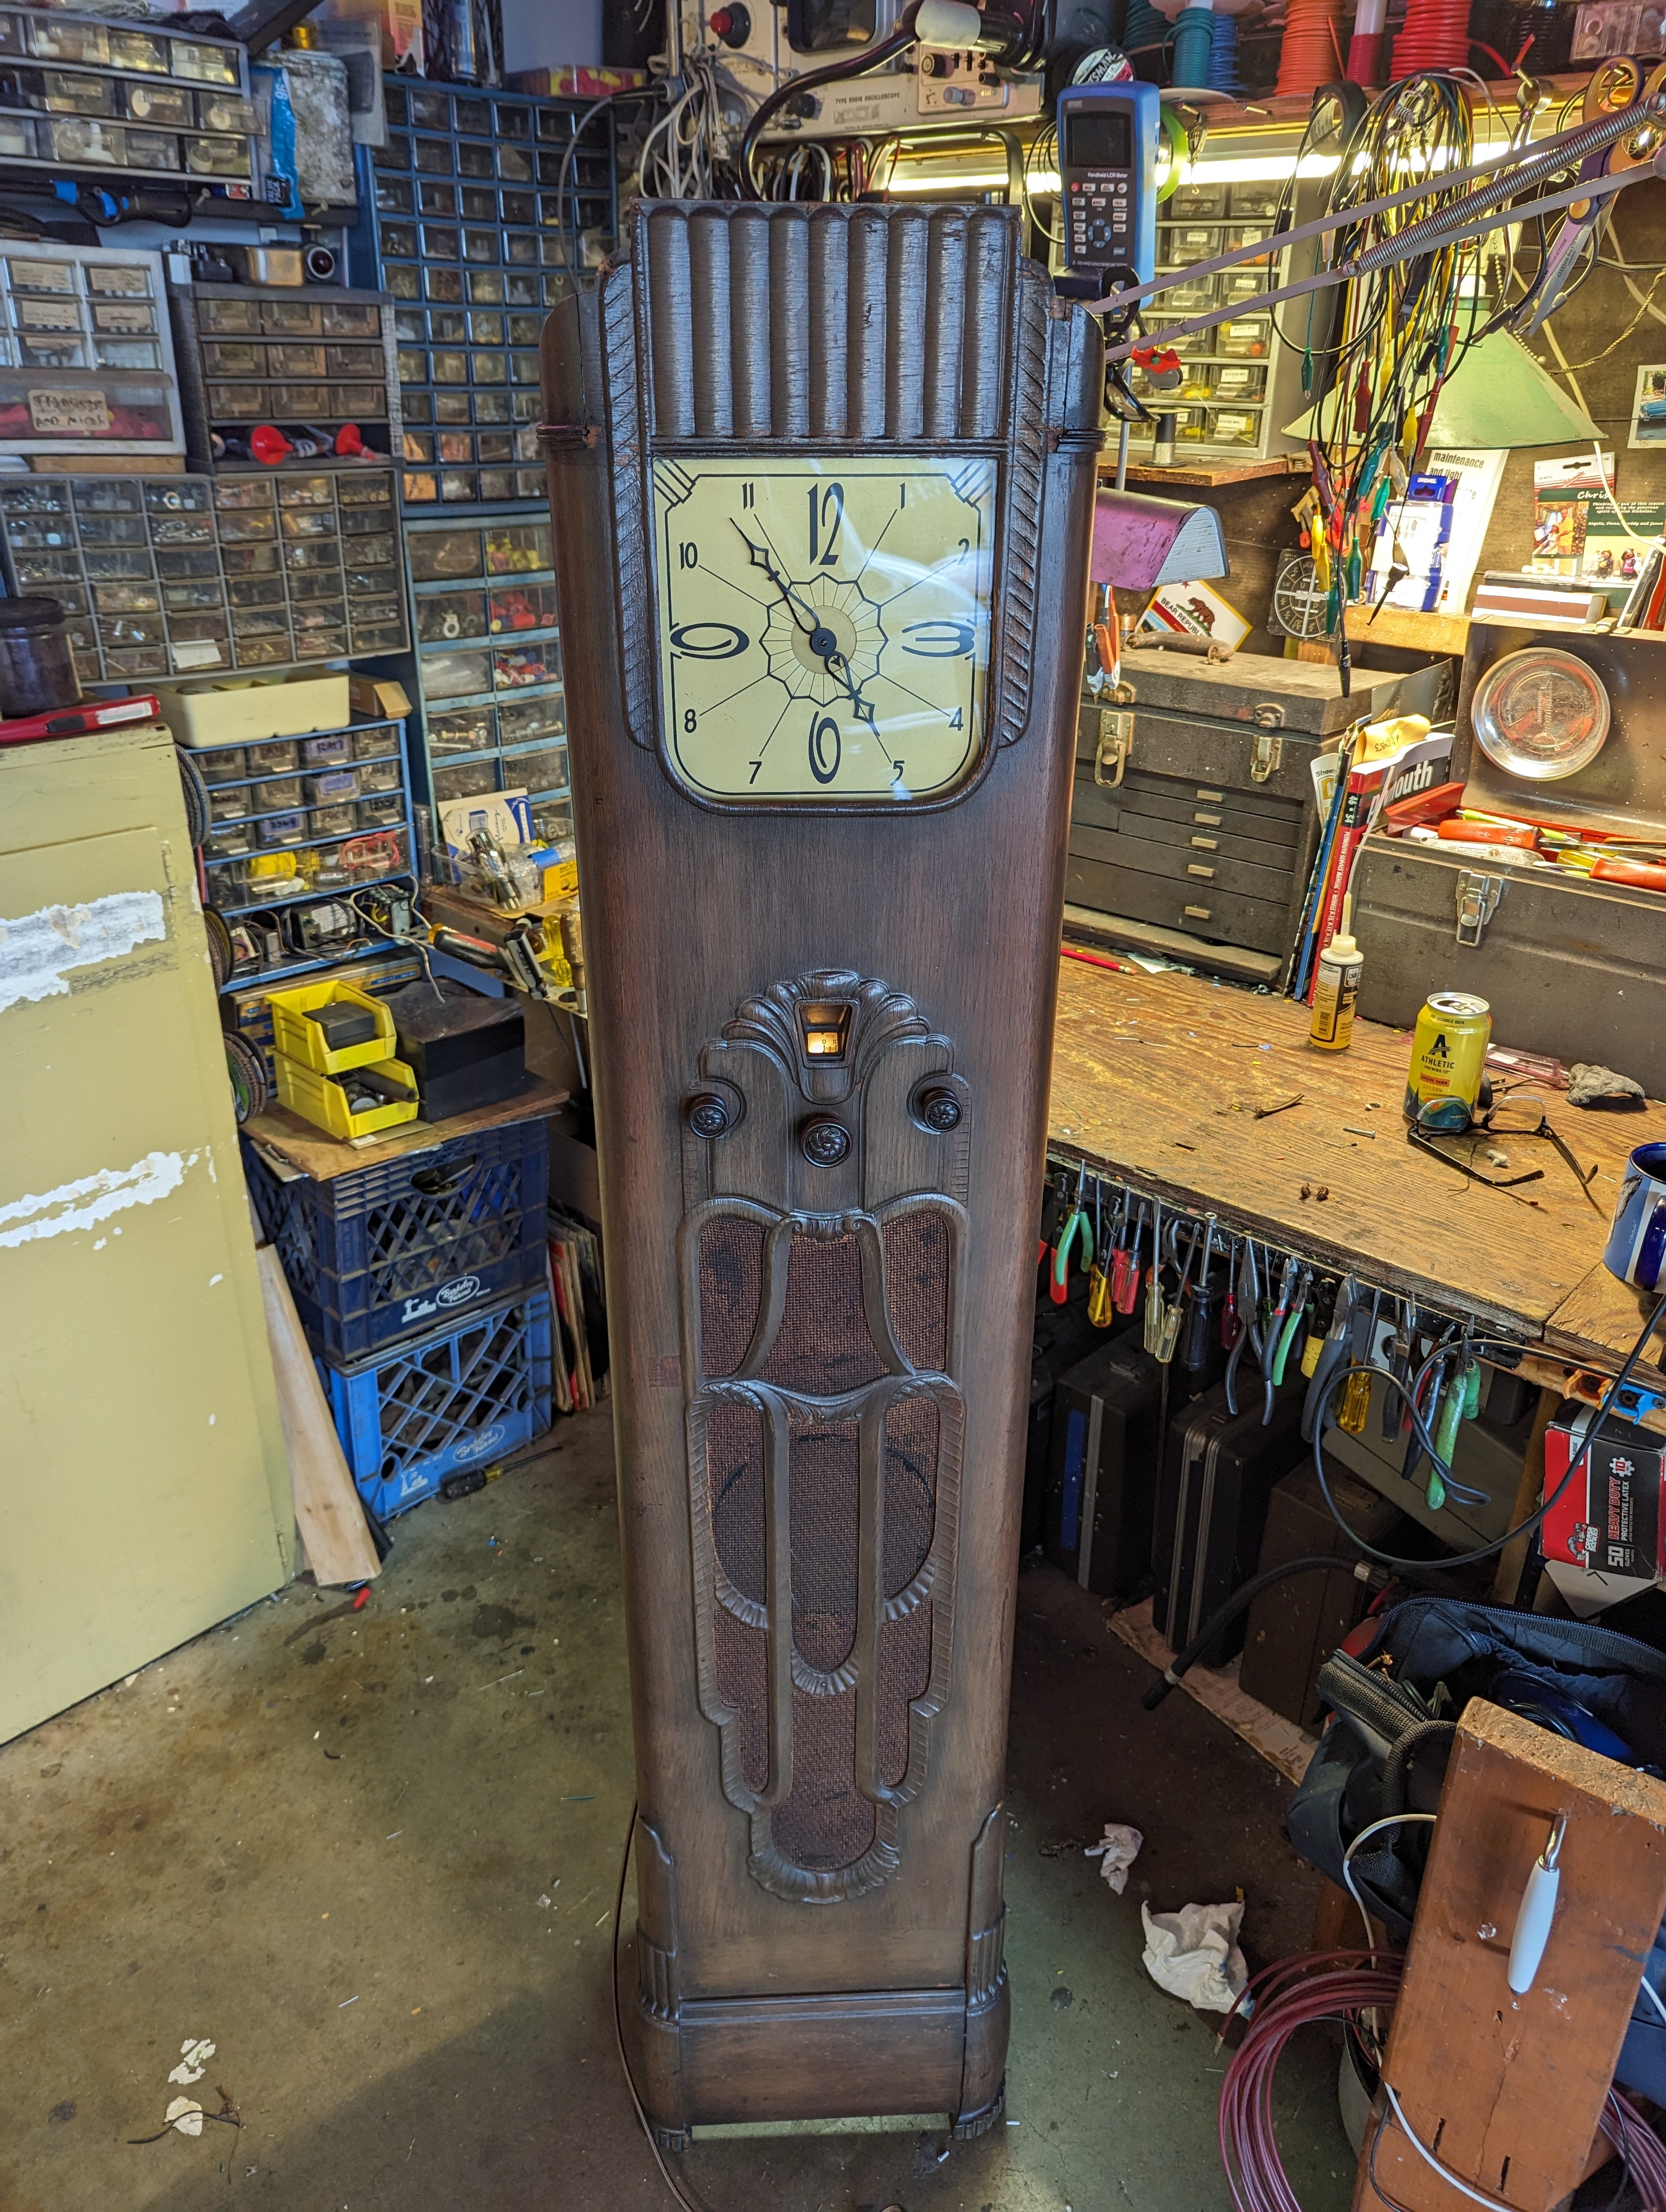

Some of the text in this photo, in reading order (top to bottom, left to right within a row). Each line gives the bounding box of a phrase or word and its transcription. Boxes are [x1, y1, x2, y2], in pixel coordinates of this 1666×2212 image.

[835, 97, 847, 105] TYPE
[864, 92, 900, 101] OSCILLOSCOPE
[1433, 452, 1485, 469] maintenance
[1429, 467, 1463, 481] and light
[741, 482, 754, 510] 11
[899, 481, 906, 510] 1
[806, 482, 844, 566] 12
[679, 542, 698, 570] 10
[958, 538, 970, 565] 2
[1161, 597, 1178, 615] BEAR
[670, 622, 749, 659] 9
[902, 621, 975, 658] 3
[684, 709, 697, 734] 8
[950, 706, 964, 732] 4
[808, 711, 842, 785] 6
[748, 761, 762, 785] 7
[890, 760, 906, 786] 5
[1344, 794, 1359, 824] 46 54
[1341, 831, 1350, 853] PLYMOUTH
[1337, 854, 1346, 871] SERVICE
[1334, 871, 1343, 889] MANUAL
[1330, 893, 1338, 911] MODELS
[1421, 1055, 1455, 1069] ATHLETIC
[1424, 1064, 1442, 1073] BREWING
[1421, 1075, 1434, 1083] UPSIDE
[1422, 1084, 1443, 1093] GOLDEN
[440, 1279, 474, 1299] Berkeley
[1615, 1460, 1626, 1472] 10
[1607, 1476, 1621, 1540] HEAVY DUTY
[1621, 1502, 1629, 1541] PROTECTIVE
[1607, 1545, 1624, 1567] 50
